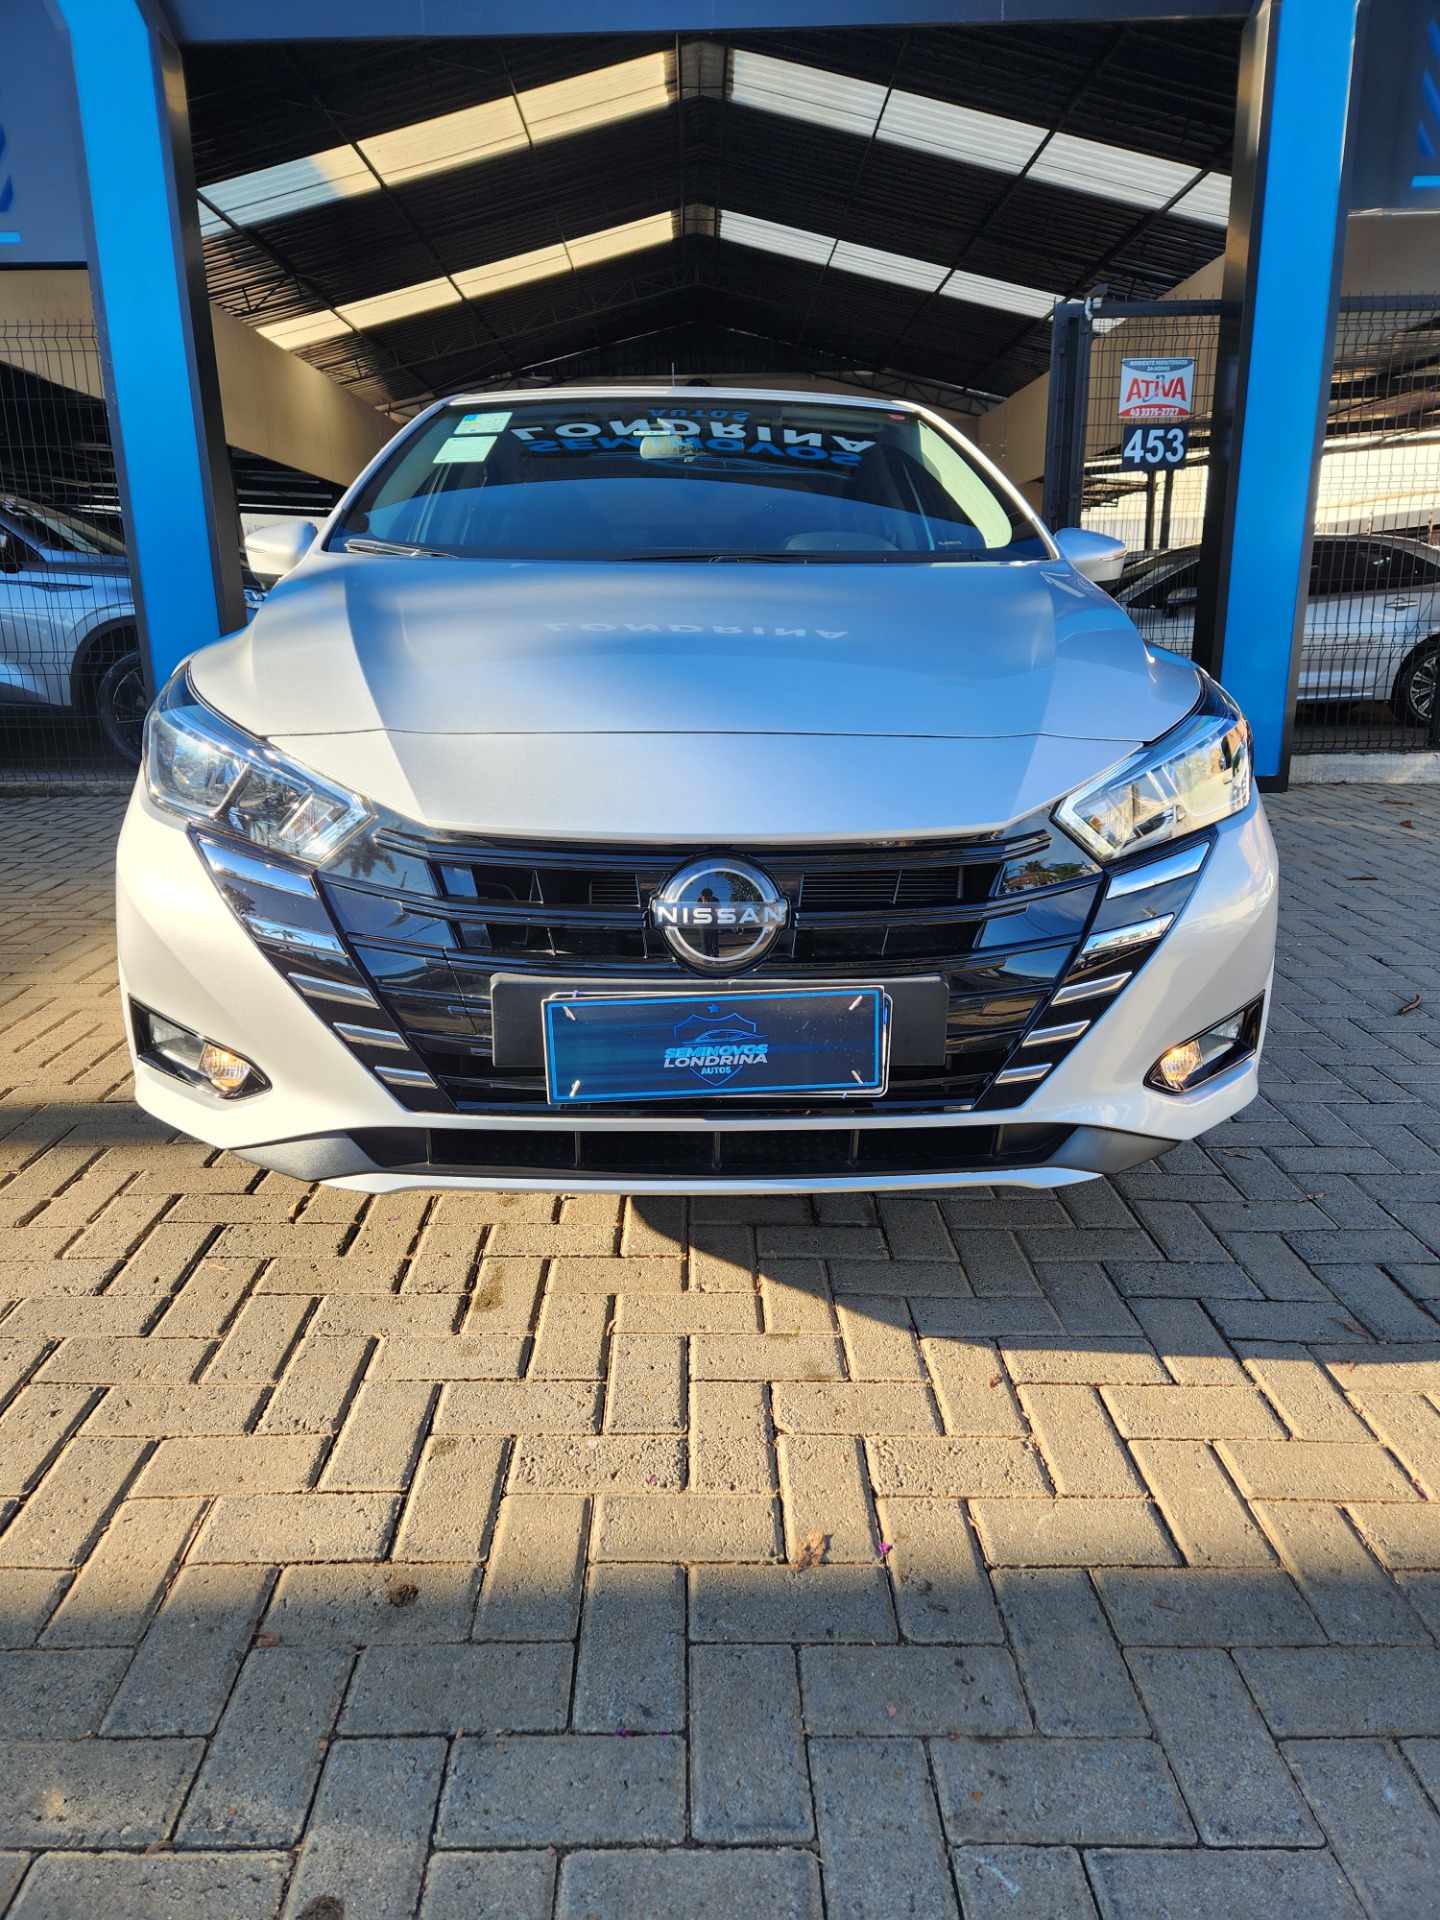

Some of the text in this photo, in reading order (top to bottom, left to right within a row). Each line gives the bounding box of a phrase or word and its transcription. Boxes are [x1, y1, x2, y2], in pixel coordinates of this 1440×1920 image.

[1125, 375, 1187, 403] ATIVA
[1123, 428, 1185, 464] 453
[658, 906, 783, 925] NISSAN
[664, 1043, 769, 1059] SEMINOVOS
[664, 1053, 768, 1068] LONDRINA
[701, 1066, 732, 1075] AUTOS
